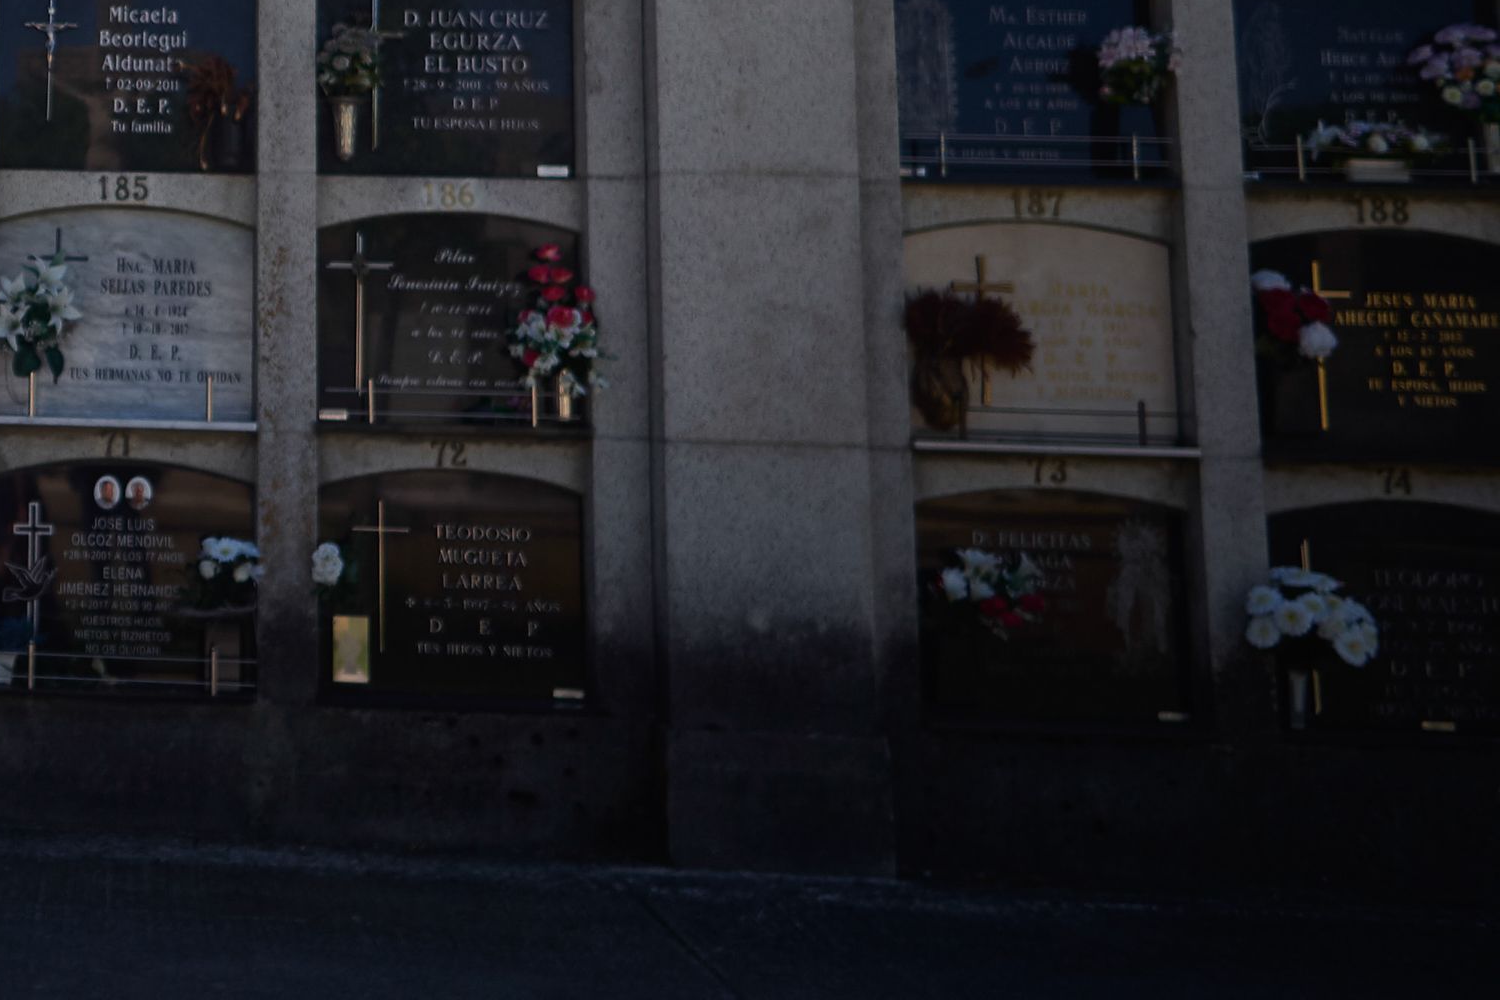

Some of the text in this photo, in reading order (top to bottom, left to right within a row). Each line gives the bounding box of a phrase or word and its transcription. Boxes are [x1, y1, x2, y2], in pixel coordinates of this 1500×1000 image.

[109, 7, 179, 24] Micaela
[100, 176, 148, 200] 185
[425, 184, 474, 207] 186
[1013, 189, 1063, 218] 187
[1355, 200, 1410, 224] 188
[430, 441, 468, 466] 72
[1029, 458, 1067, 483] 73
[435, 523, 532, 543] TEODOSIO
[437, 548, 528, 568] MUGUETA
[102, 566, 143, 580] ELENA
